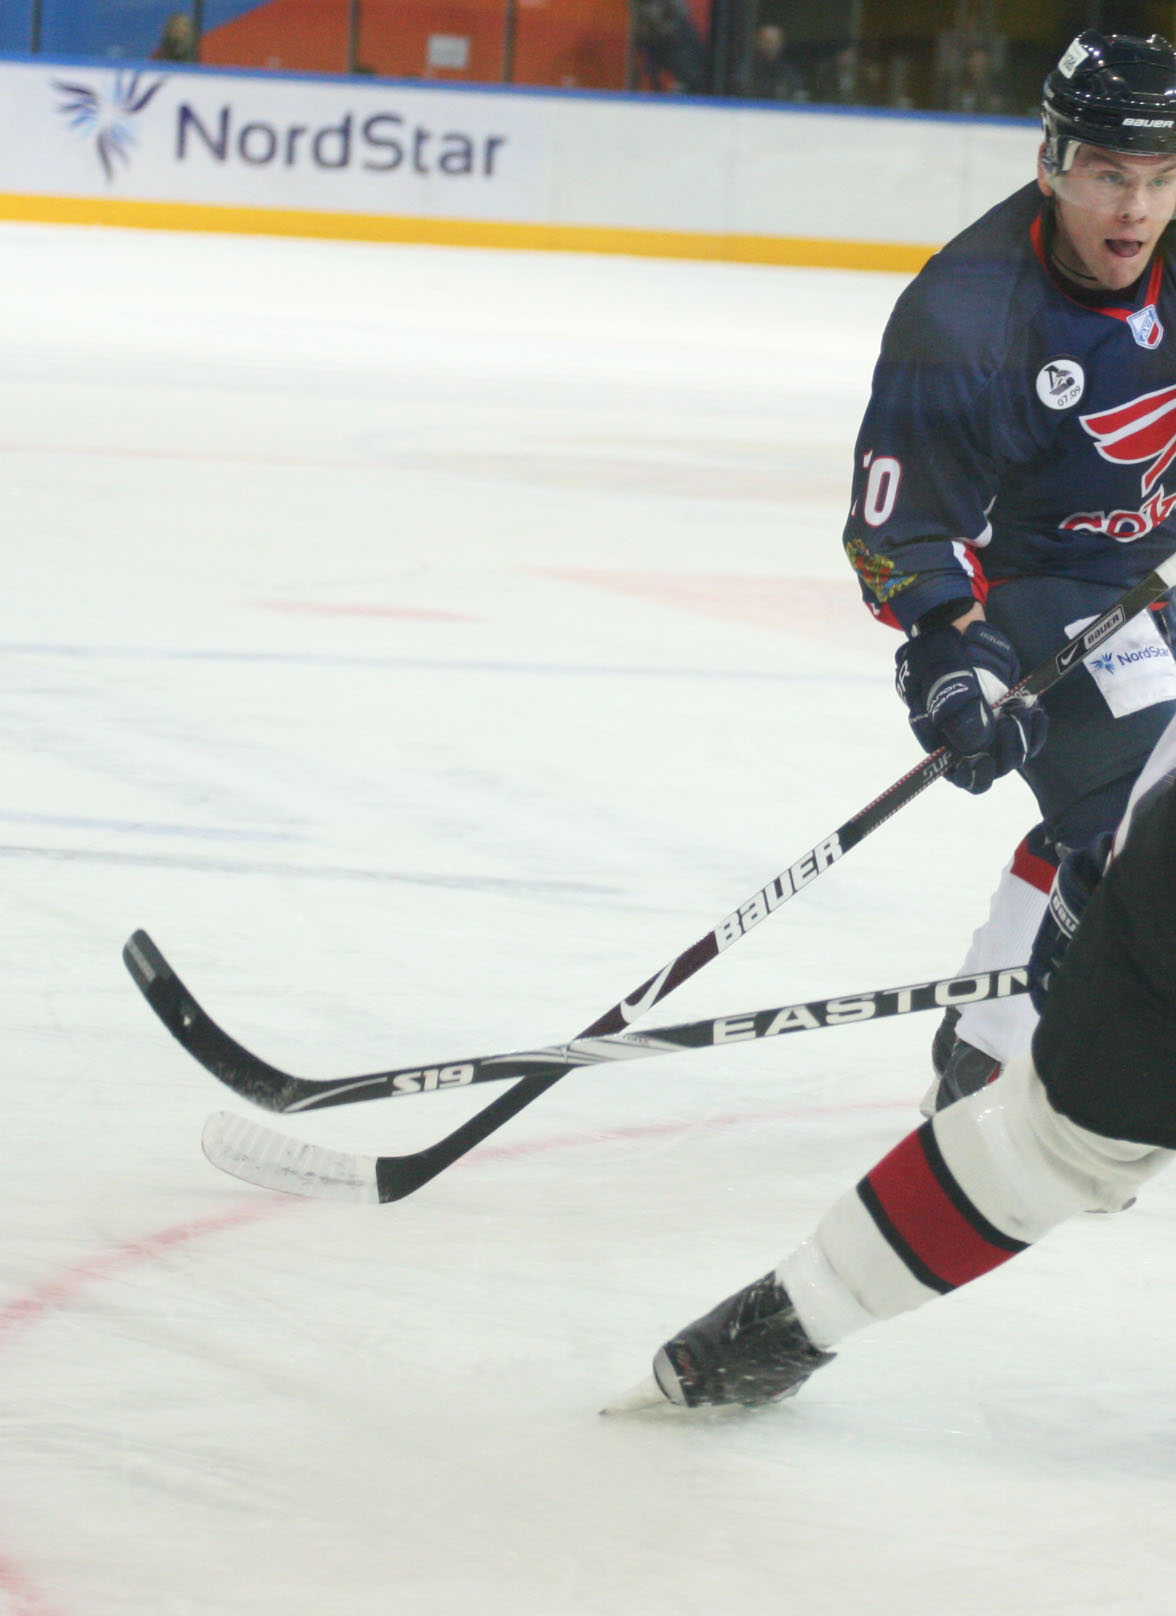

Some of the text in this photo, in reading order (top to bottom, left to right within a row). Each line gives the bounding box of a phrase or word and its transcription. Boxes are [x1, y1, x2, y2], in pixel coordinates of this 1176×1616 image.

[174, 102, 509, 178] NordStar
[1057, 384, 1082, 408] 07.09
[1086, 613, 1121, 645] BAUER
[714, 831, 844, 954] BAUER
[713, 967, 1029, 1046] EASTON
[391, 1063, 475, 1098] S19
